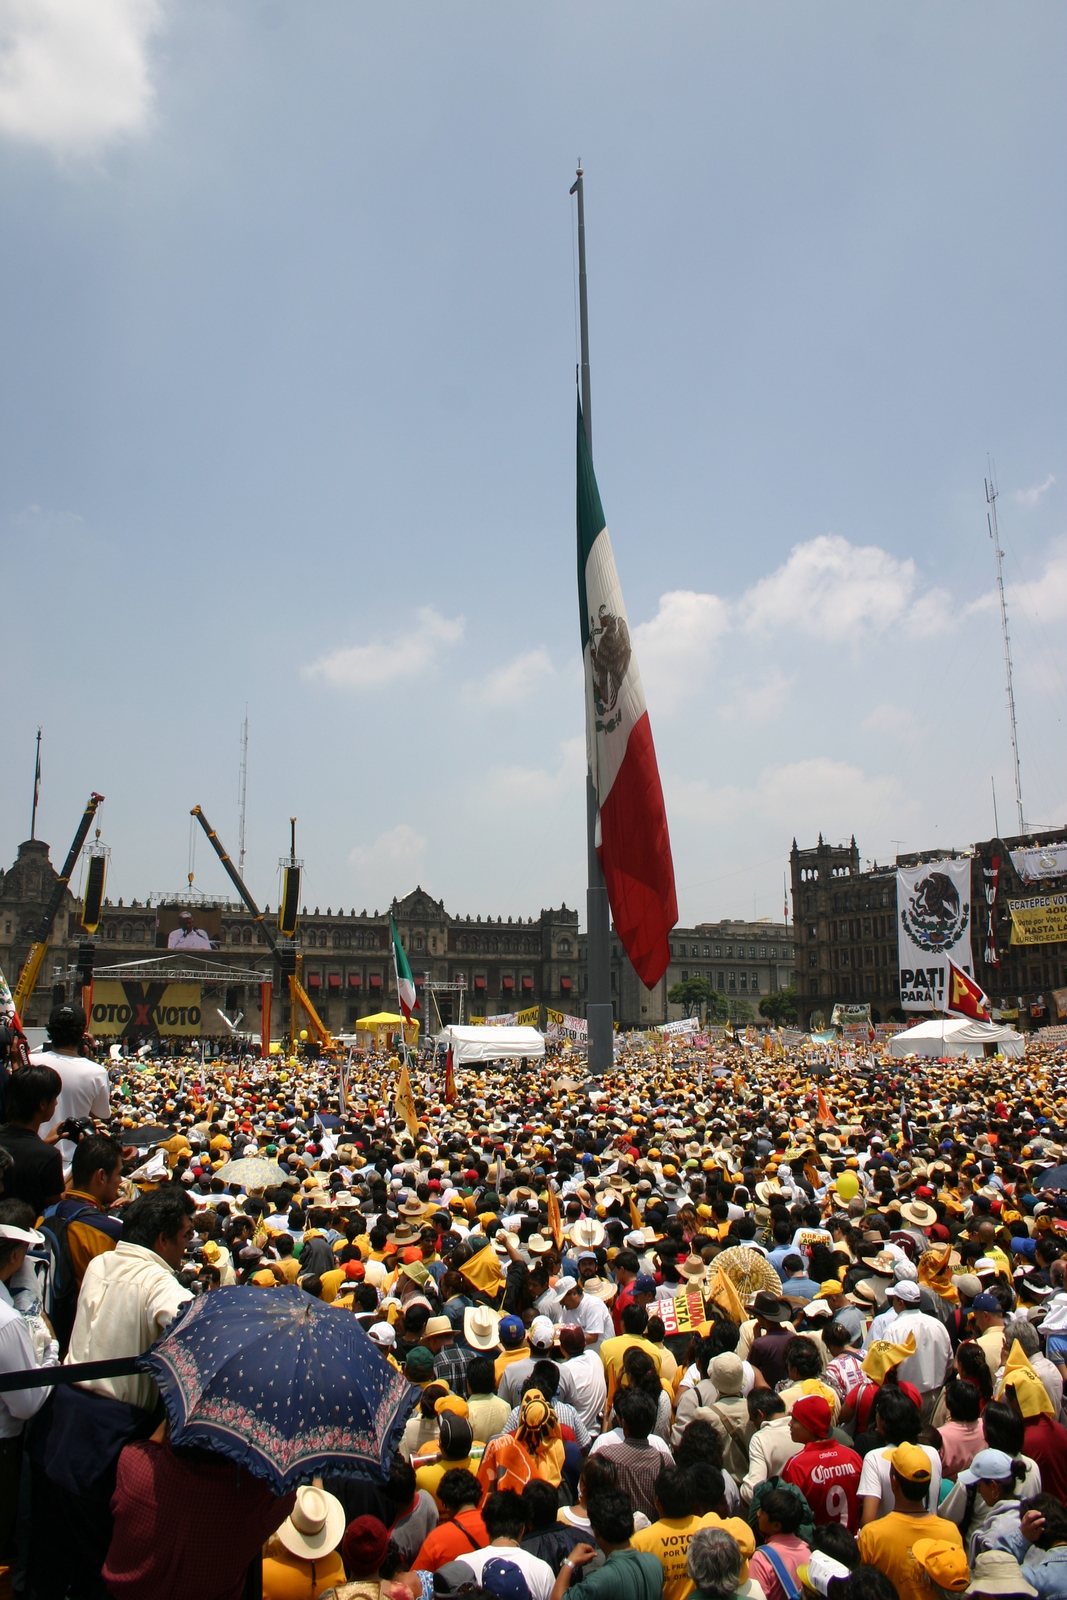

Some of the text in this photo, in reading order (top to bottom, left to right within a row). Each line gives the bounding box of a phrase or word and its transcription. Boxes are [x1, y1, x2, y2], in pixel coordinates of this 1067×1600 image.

[1010, 897, 1050, 911] ECATEPEC
[1025, 926, 1055, 934] HASTA
[901, 990, 933, 1002] PARA
[157, 1005, 202, 1026] VOTO
[811, 1462, 856, 1484] Corona
[826, 1484, 849, 1528] 9
[664, 1550, 680, 1558] POR
